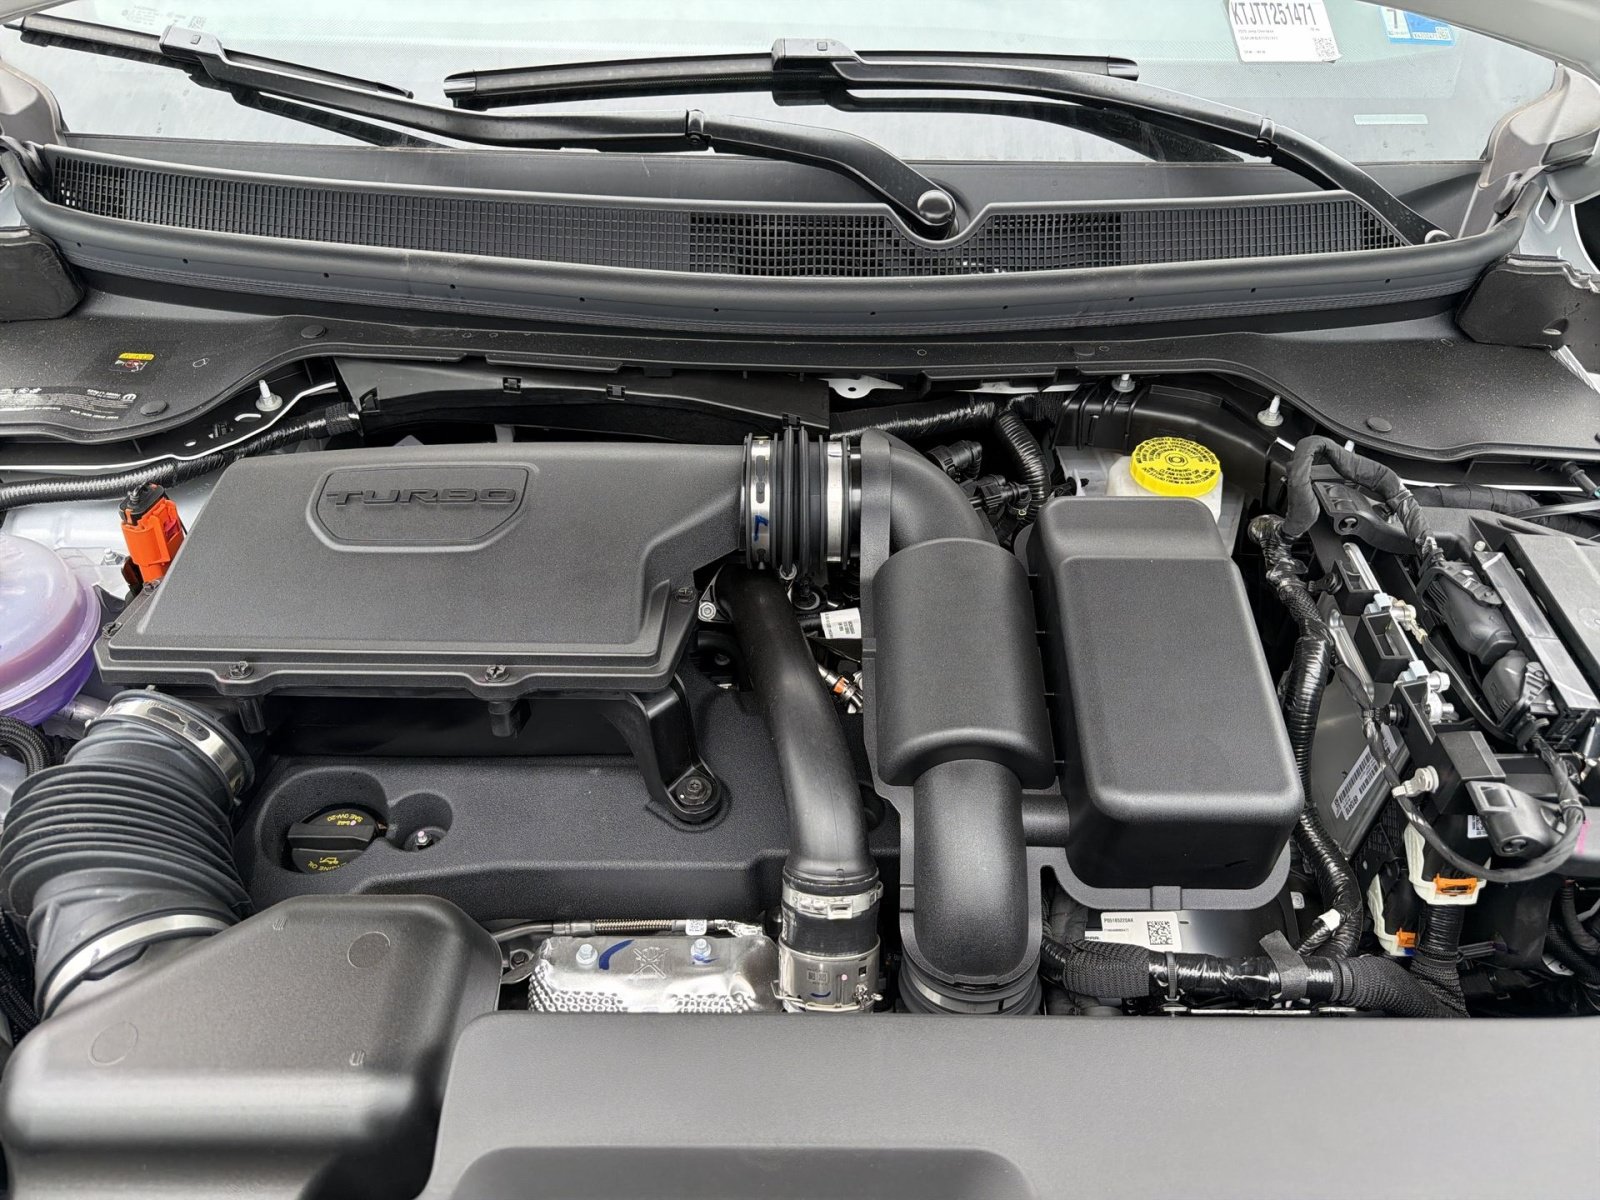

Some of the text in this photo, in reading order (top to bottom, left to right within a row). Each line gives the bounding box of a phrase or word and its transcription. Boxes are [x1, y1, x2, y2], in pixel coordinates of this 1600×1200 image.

[1231, 2, 1317, 26] KTJTT251471
[326, 488, 518, 506] TURBO
[350, 813, 364, 823] SAE
